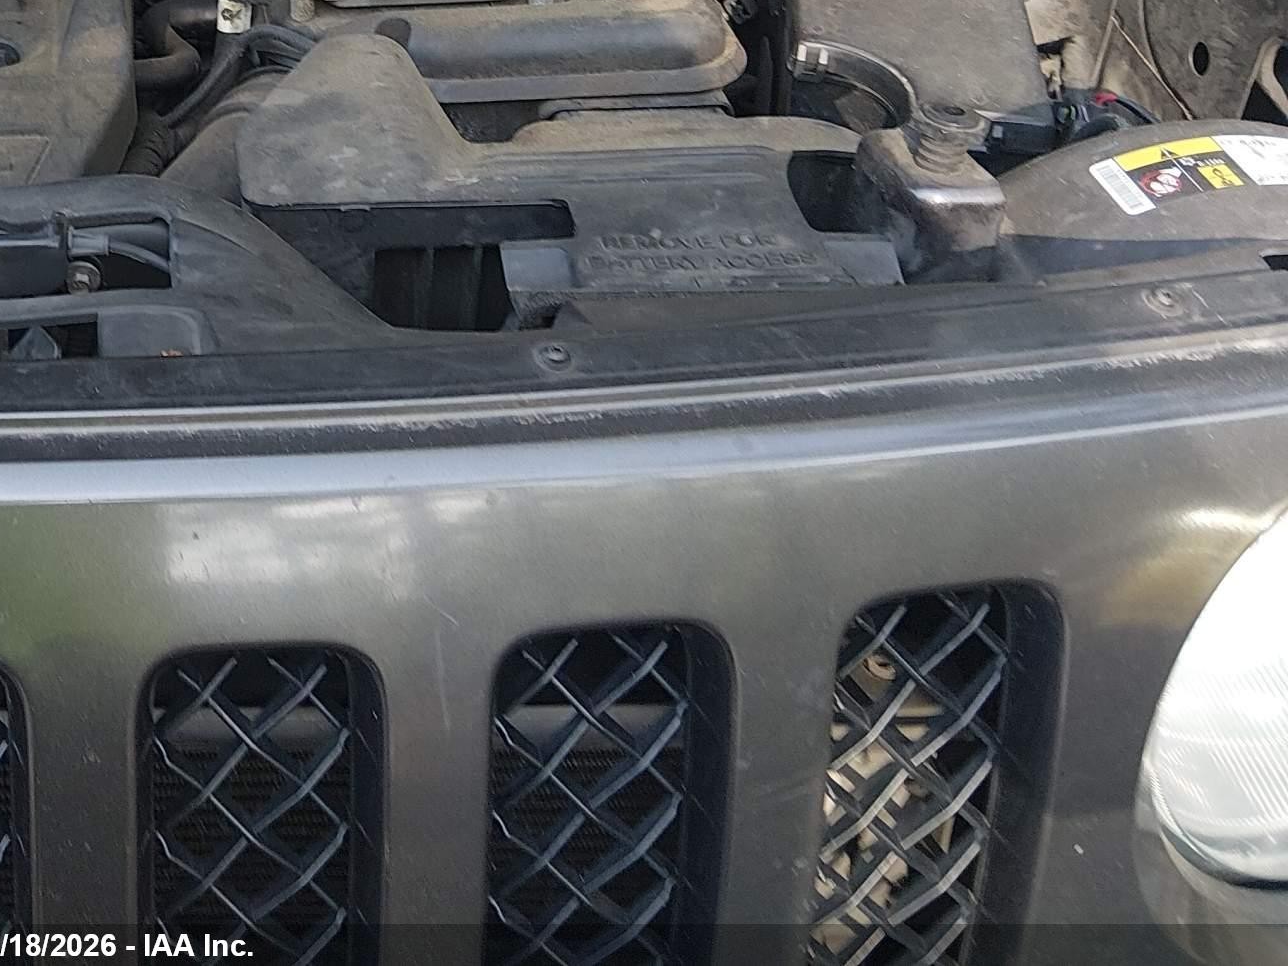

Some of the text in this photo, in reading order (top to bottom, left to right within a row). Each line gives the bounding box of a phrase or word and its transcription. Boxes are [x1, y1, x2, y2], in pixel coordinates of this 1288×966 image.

[598, 232, 778, 251] REMOVE FOR
[584, 250, 819, 272] BATTERY ACCESS
